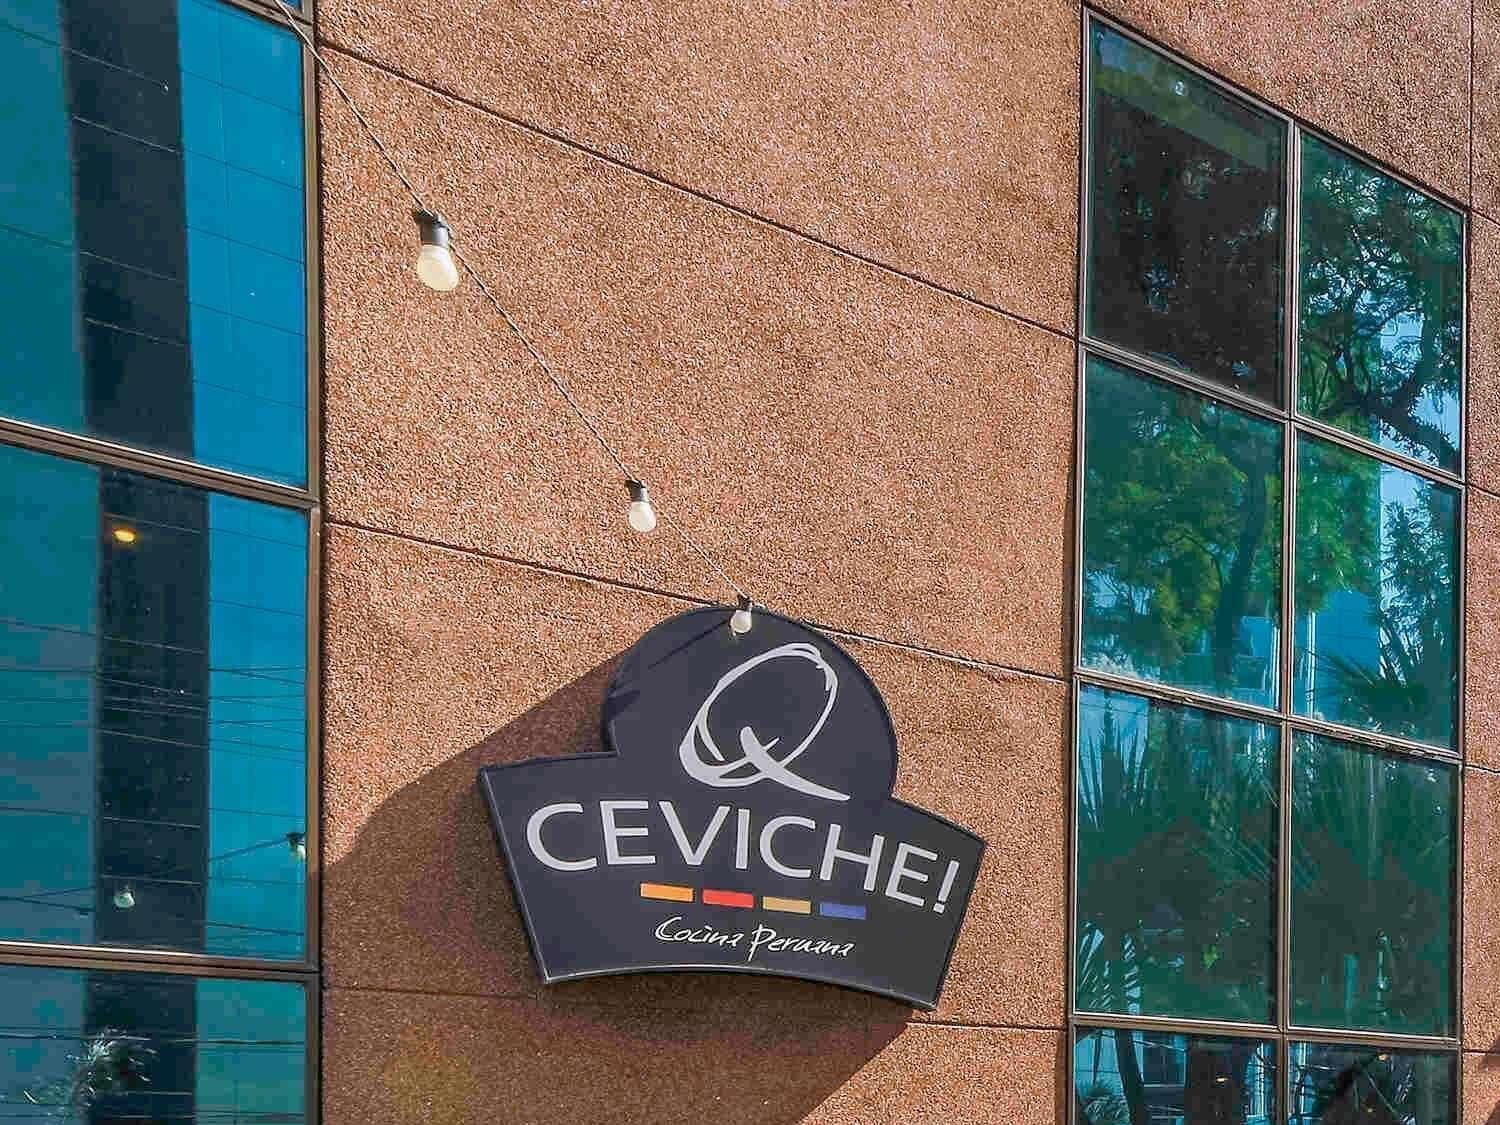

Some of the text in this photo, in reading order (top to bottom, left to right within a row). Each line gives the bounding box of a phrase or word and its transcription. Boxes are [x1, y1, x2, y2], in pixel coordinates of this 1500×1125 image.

[679, 642, 850, 801] Q
[525, 799, 960, 914] CEVICHE!
[655, 915, 856, 961] Cocina Peruana
